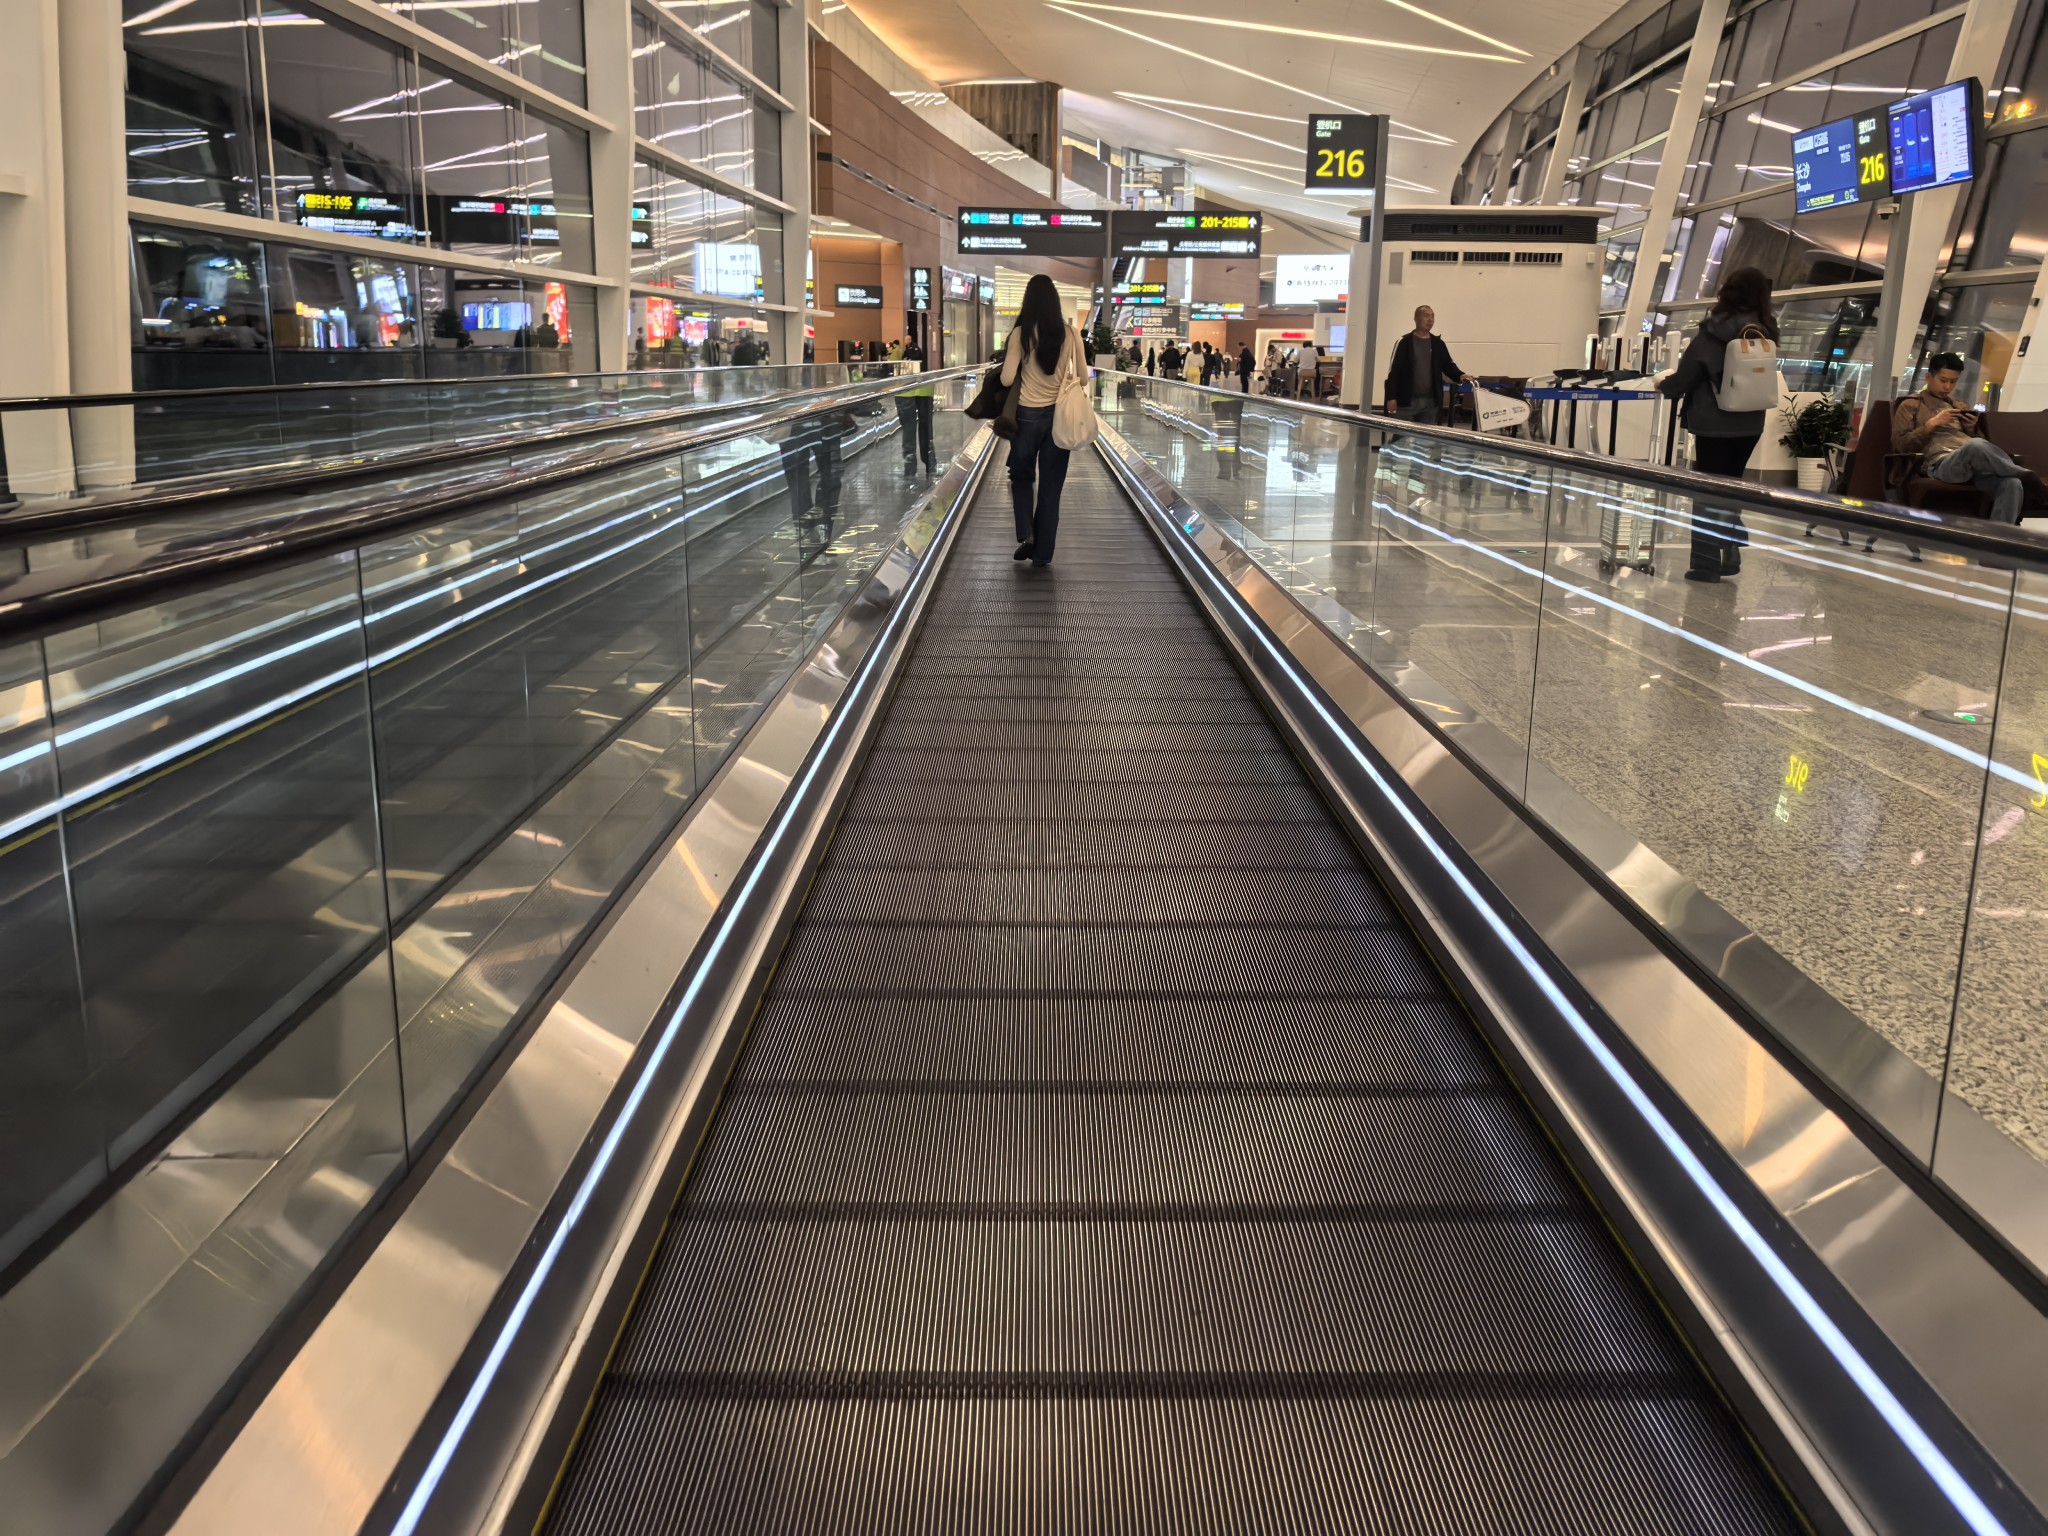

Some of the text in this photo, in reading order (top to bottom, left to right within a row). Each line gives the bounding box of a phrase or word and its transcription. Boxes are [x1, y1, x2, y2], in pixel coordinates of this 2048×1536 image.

[1316, 120, 1342, 130] 登机口
[1316, 149, 1365, 178] 216
[1795, 161, 1811, 180] 长沙
[1860, 153, 1885, 184] 216
[1200, 216, 1239, 228] 201-215
